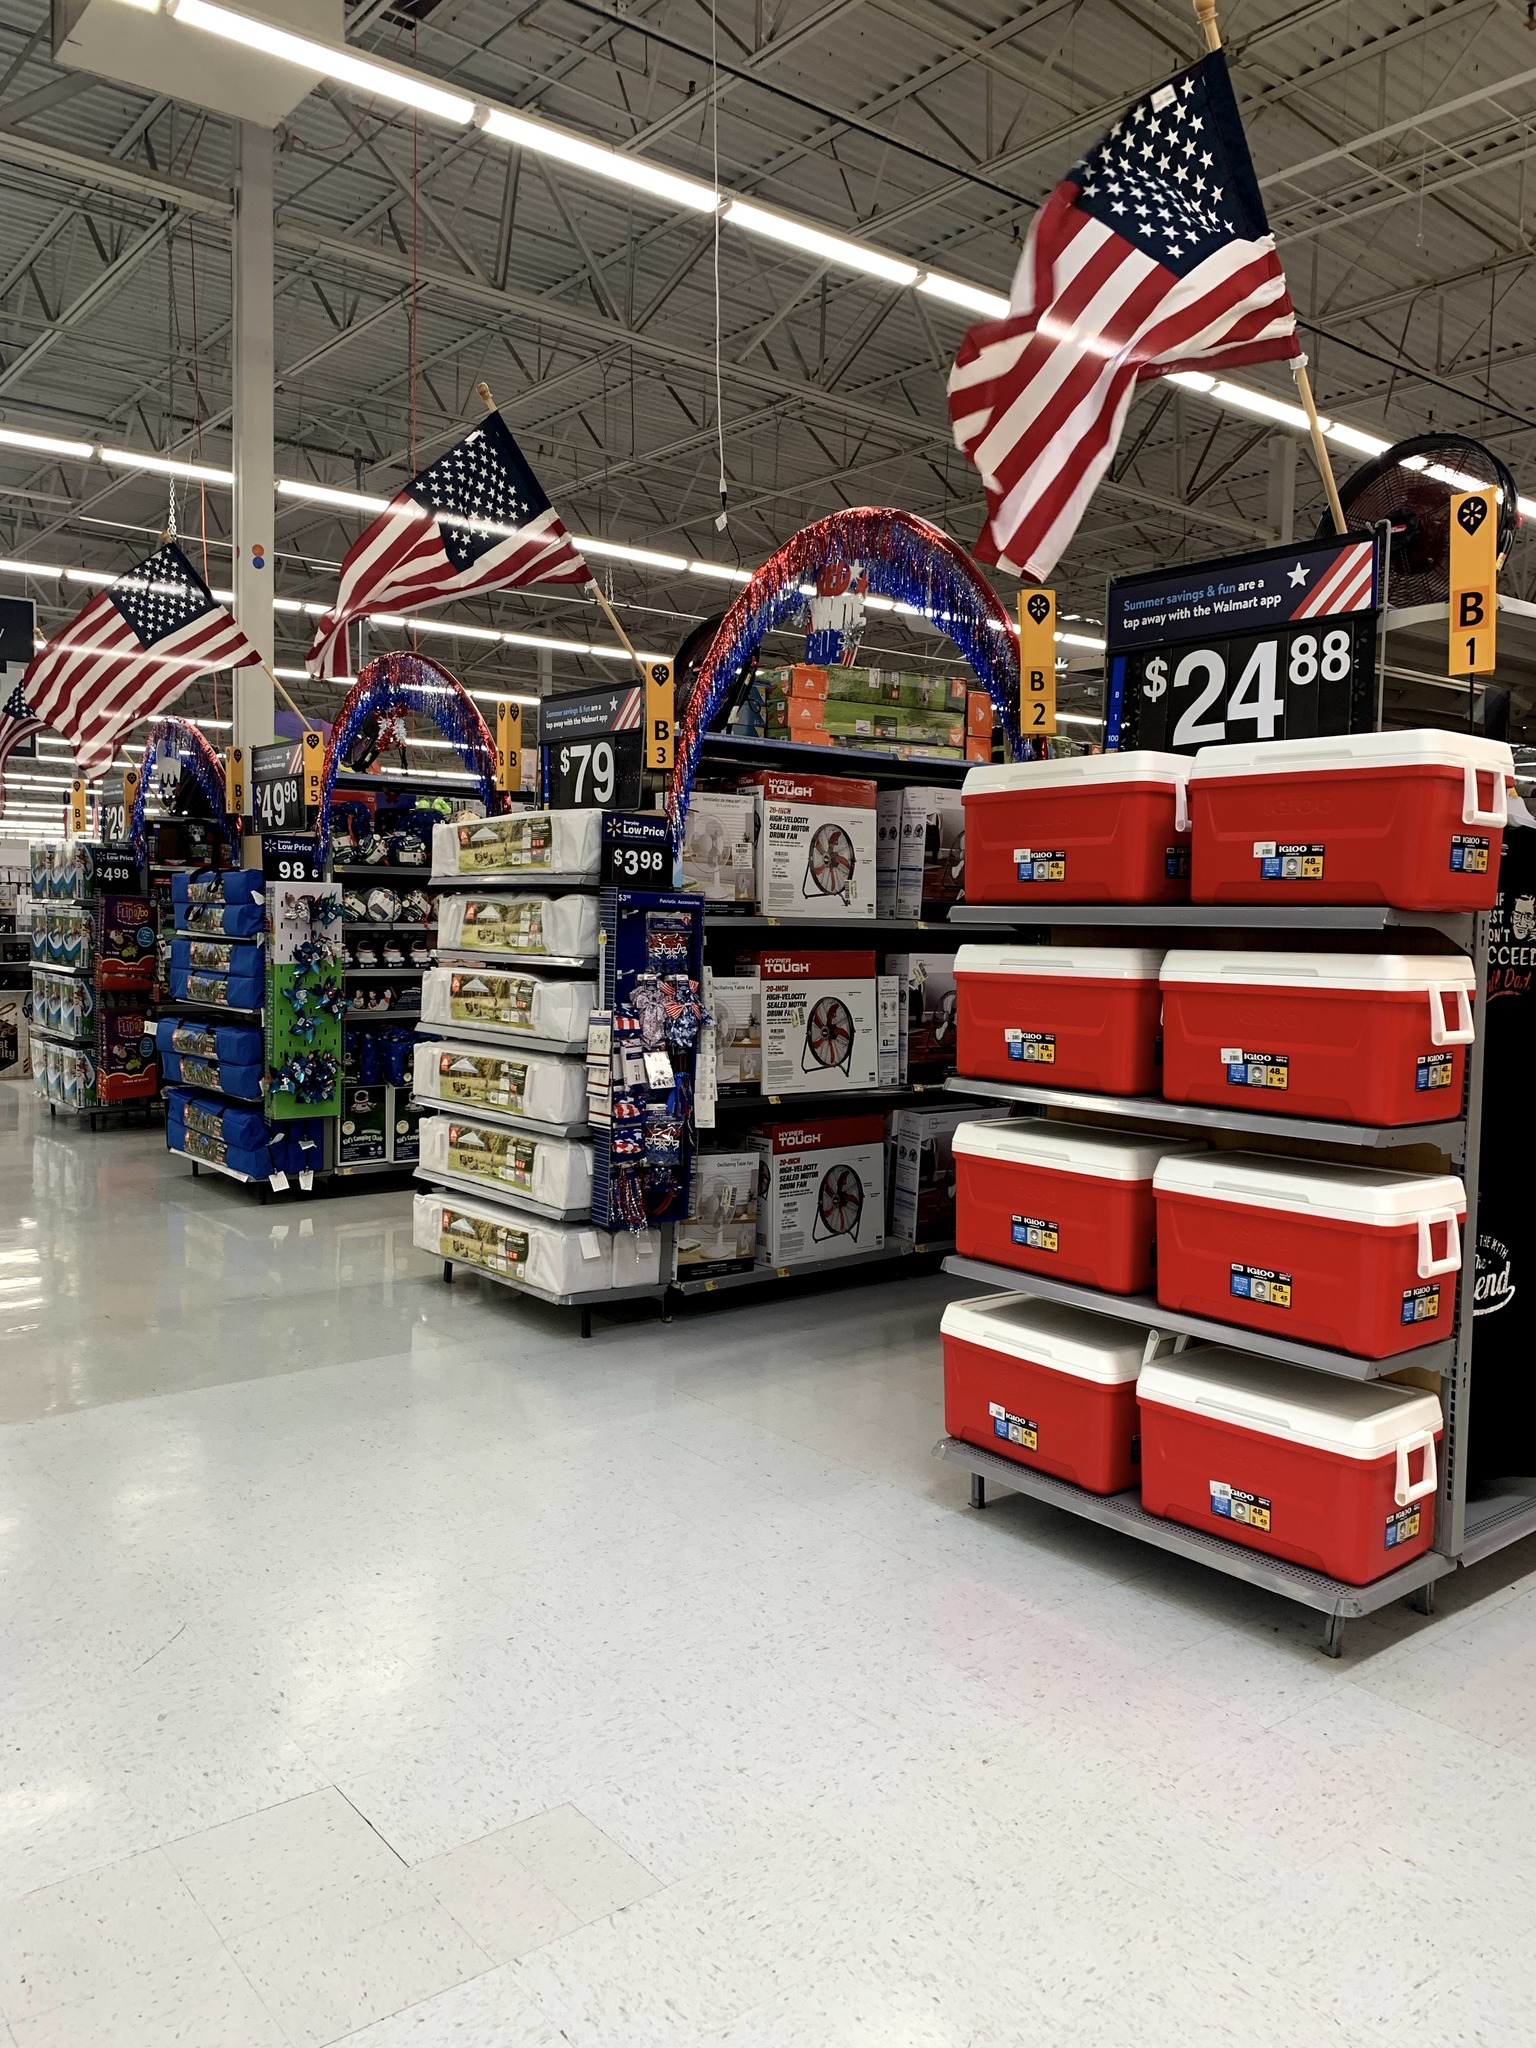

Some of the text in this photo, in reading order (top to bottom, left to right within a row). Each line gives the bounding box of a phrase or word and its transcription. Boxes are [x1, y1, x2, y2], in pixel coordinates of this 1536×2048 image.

[1123, 579, 1265, 612] Summer savings & fun are a
[1123, 594, 1282, 630] tap away with the Walmart app
[1460, 592, 1484, 627] B
[805, 629, 845, 665] BLUE
[1466, 638, 1475, 665] 1
[1031, 671, 1045, 692] B
[546, 709, 563, 718] Summer
[563, 707, 578, 717] savings
[1033, 703, 1046, 726] 2
[581, 715, 599, 724] Walmart
[655, 720, 670, 741] B
[510, 751, 517, 767] B
[656, 747, 666, 764] 3
[560, 742, 615, 803] $79
[310, 775, 319, 787] B
[499, 773, 504, 787] 4
[769, 778, 795, 786] HYPER
[235, 784, 242, 798] B
[310, 790, 318, 802] 5
[769, 785, 813, 797] TOUGH
[235, 800, 241, 811] 6
[769, 806, 792, 814] 20-INCH
[75, 809, 81, 818] B
[769, 815, 809, 824] HIGH-VELOCITY
[75, 821, 81, 830] 8
[623, 825, 642, 835] Low
[642, 826, 665, 837] Price
[769, 822, 790, 831] SEALED
[1462, 836, 1480, 845] IGLOO
[278, 842, 313, 852] Low Price
[1279, 845, 1307, 853] IGLOO
[119, 854, 134, 862] Price
[1304, 857, 1316, 865] 48
[1488, 926, 1511, 943] ON'T
[1487, 945, 1536, 967] CCEED
[764, 963, 809, 973] TOUGH
[766, 985, 789, 993] 20-INCH
[766, 993, 807, 1001] HIGH-VELOCITY
[767, 1001, 787, 1009] SEALED
[1040, 1044, 1049, 1052] 48
[1243, 1053, 1272, 1062] IGLOO
[1427, 1053, 1445, 1063] IGLOO
[1269, 1067, 1281, 1075] 48
[779, 1130, 804, 1138] HYPER
[779, 1134, 821, 1147] TOUGH
[779, 1157, 801, 1166] 20-INCH
[779, 1163, 819, 1174] HIGH-VELOCITY
[779, 1171, 819, 1183] SEALED MOTOR
[779, 1181, 808, 1191] DRUM FAN
[1024, 1217, 1046, 1227] IGLOO
[1479, 1234, 1509, 1260] THE MYTH
[1246, 1266, 1275, 1279] IGLOO
[1474, 1261, 1511, 1301] end
[1272, 1285, 1284, 1293] 48
[1413, 1285, 1431, 1296] IGLOO
[1005, 1412, 1026, 1425] IGLOO
[1230, 1488, 1255, 1502] GLOO
[1252, 1507, 1263, 1516] 48
